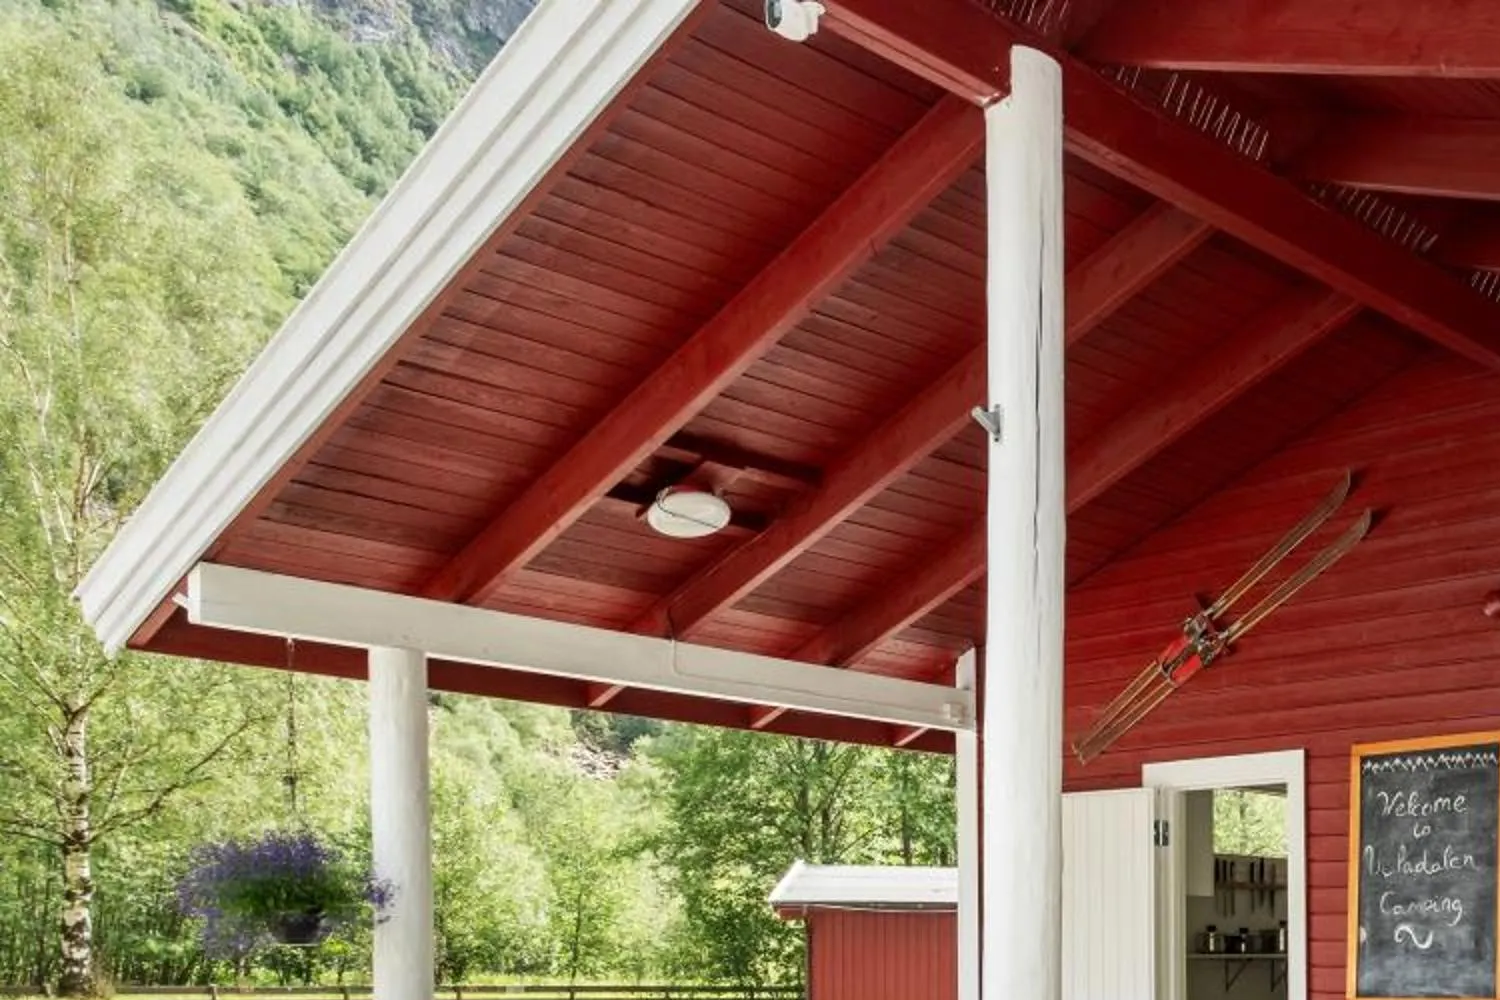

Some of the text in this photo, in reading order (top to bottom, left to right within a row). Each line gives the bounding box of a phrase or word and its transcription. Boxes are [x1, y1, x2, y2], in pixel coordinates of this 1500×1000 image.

[1377, 791, 1467, 817] Welcome
[1413, 822, 1432, 838] to
[1379, 891, 1463, 927] Camping
